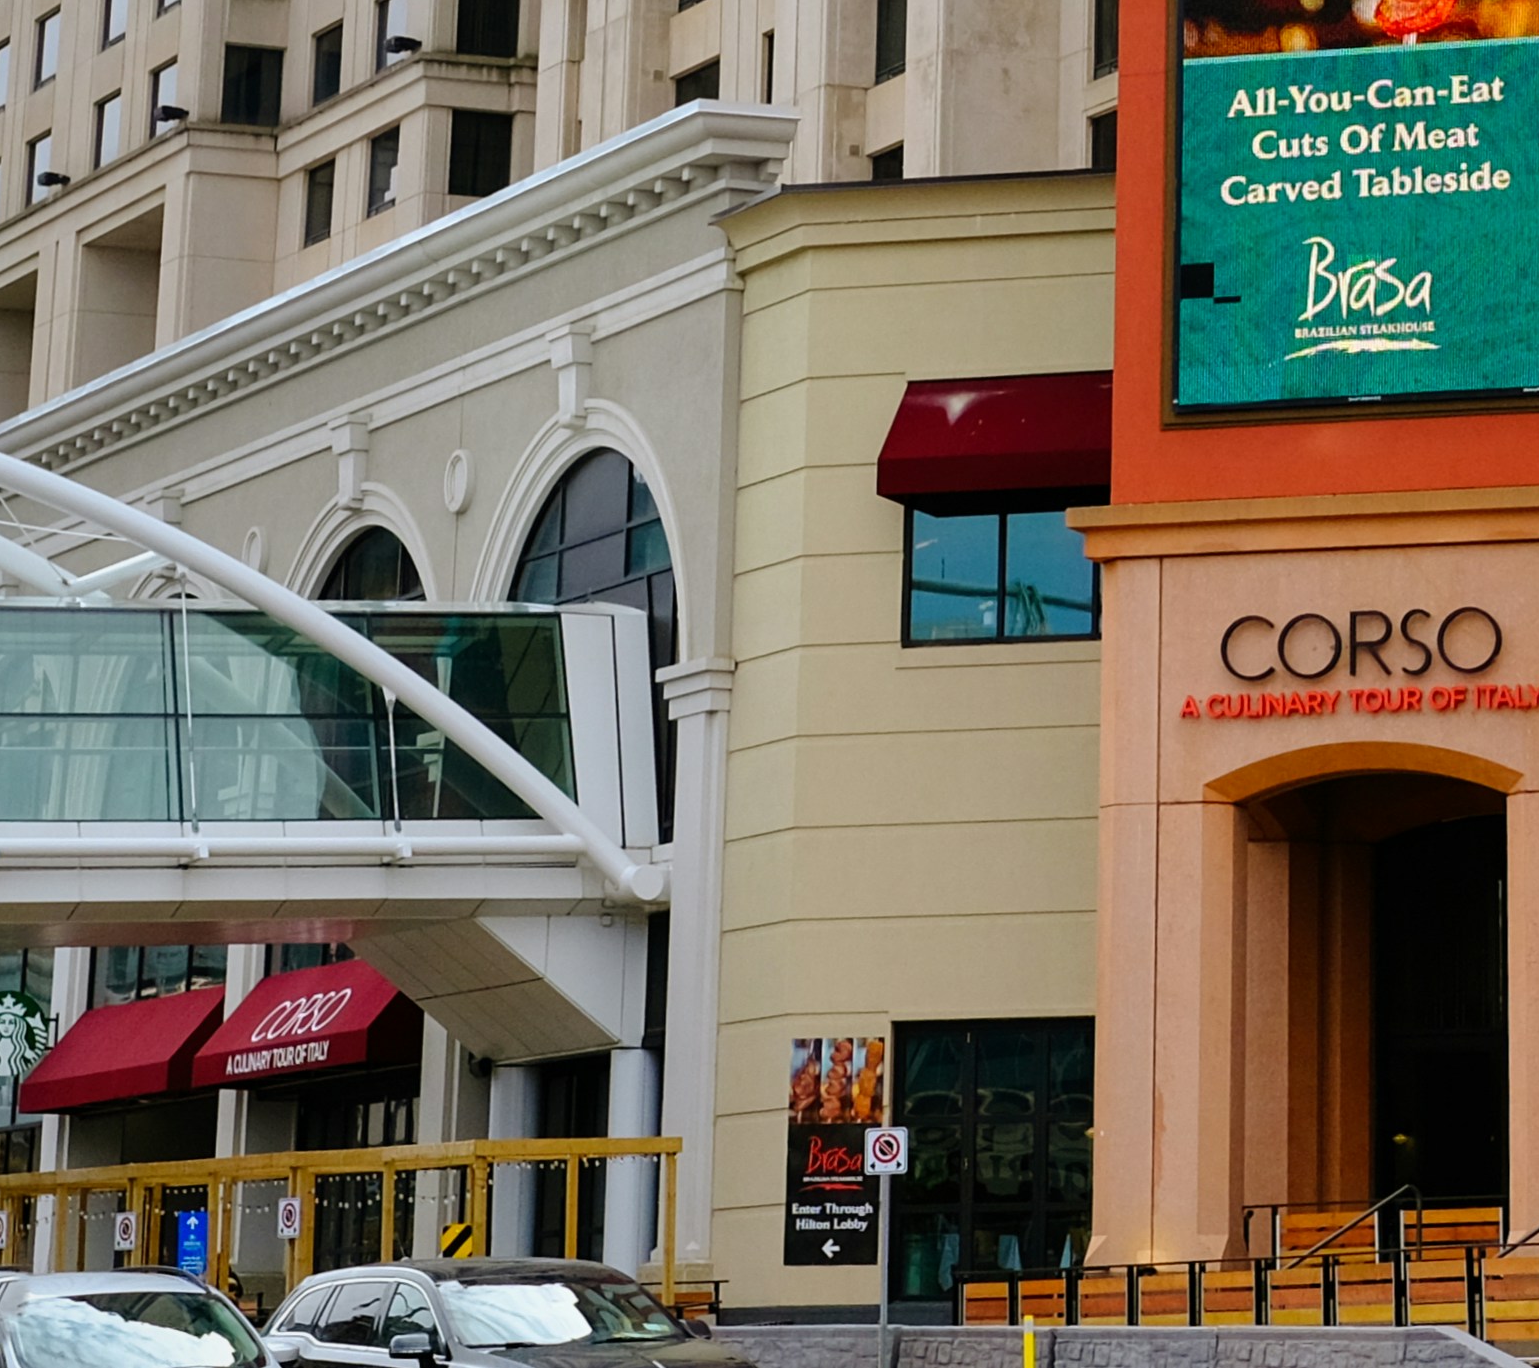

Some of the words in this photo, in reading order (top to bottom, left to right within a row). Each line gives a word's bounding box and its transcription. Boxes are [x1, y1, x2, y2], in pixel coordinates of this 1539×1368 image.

[1227, 74, 1505, 118] All-You-Can-Eat
[1251, 129, 1329, 160] Cuts
[1339, 122, 1386, 155] Of
[1392, 120, 1480, 152] Meat
[1220, 170, 1342, 206] Carved
[1352, 161, 1511, 198] Tableside
[1298, 236, 1433, 322] Brasa
[1294, 324, 1357, 339] BRAZILIAN
[1359, 321, 1436, 336] STEAKHOUSE
[1220, 606, 1503, 682] CORSO
[1180, 695, 1201, 719] A
[1205, 689, 1341, 720] CULINARY
[1347, 686, 1424, 713] TOUR
[1428, 684, 1467, 712] OF
[251, 988, 352, 1043] CORSO
[226, 1055, 233, 1075] A
[234, 1048, 272, 1074] CULINARY
[272, 1046, 294, 1068] TOUR
[295, 1044, 307, 1065] OF
[307, 1040, 330, 1062] ITALY
[805, 1135, 863, 1175] Brasa
[791, 1203, 822, 1215] Enter
[824, 1203, 874, 1216] Through
[795, 1218, 831, 1231] Hilton
[833, 1218, 868, 1232] Lobby
